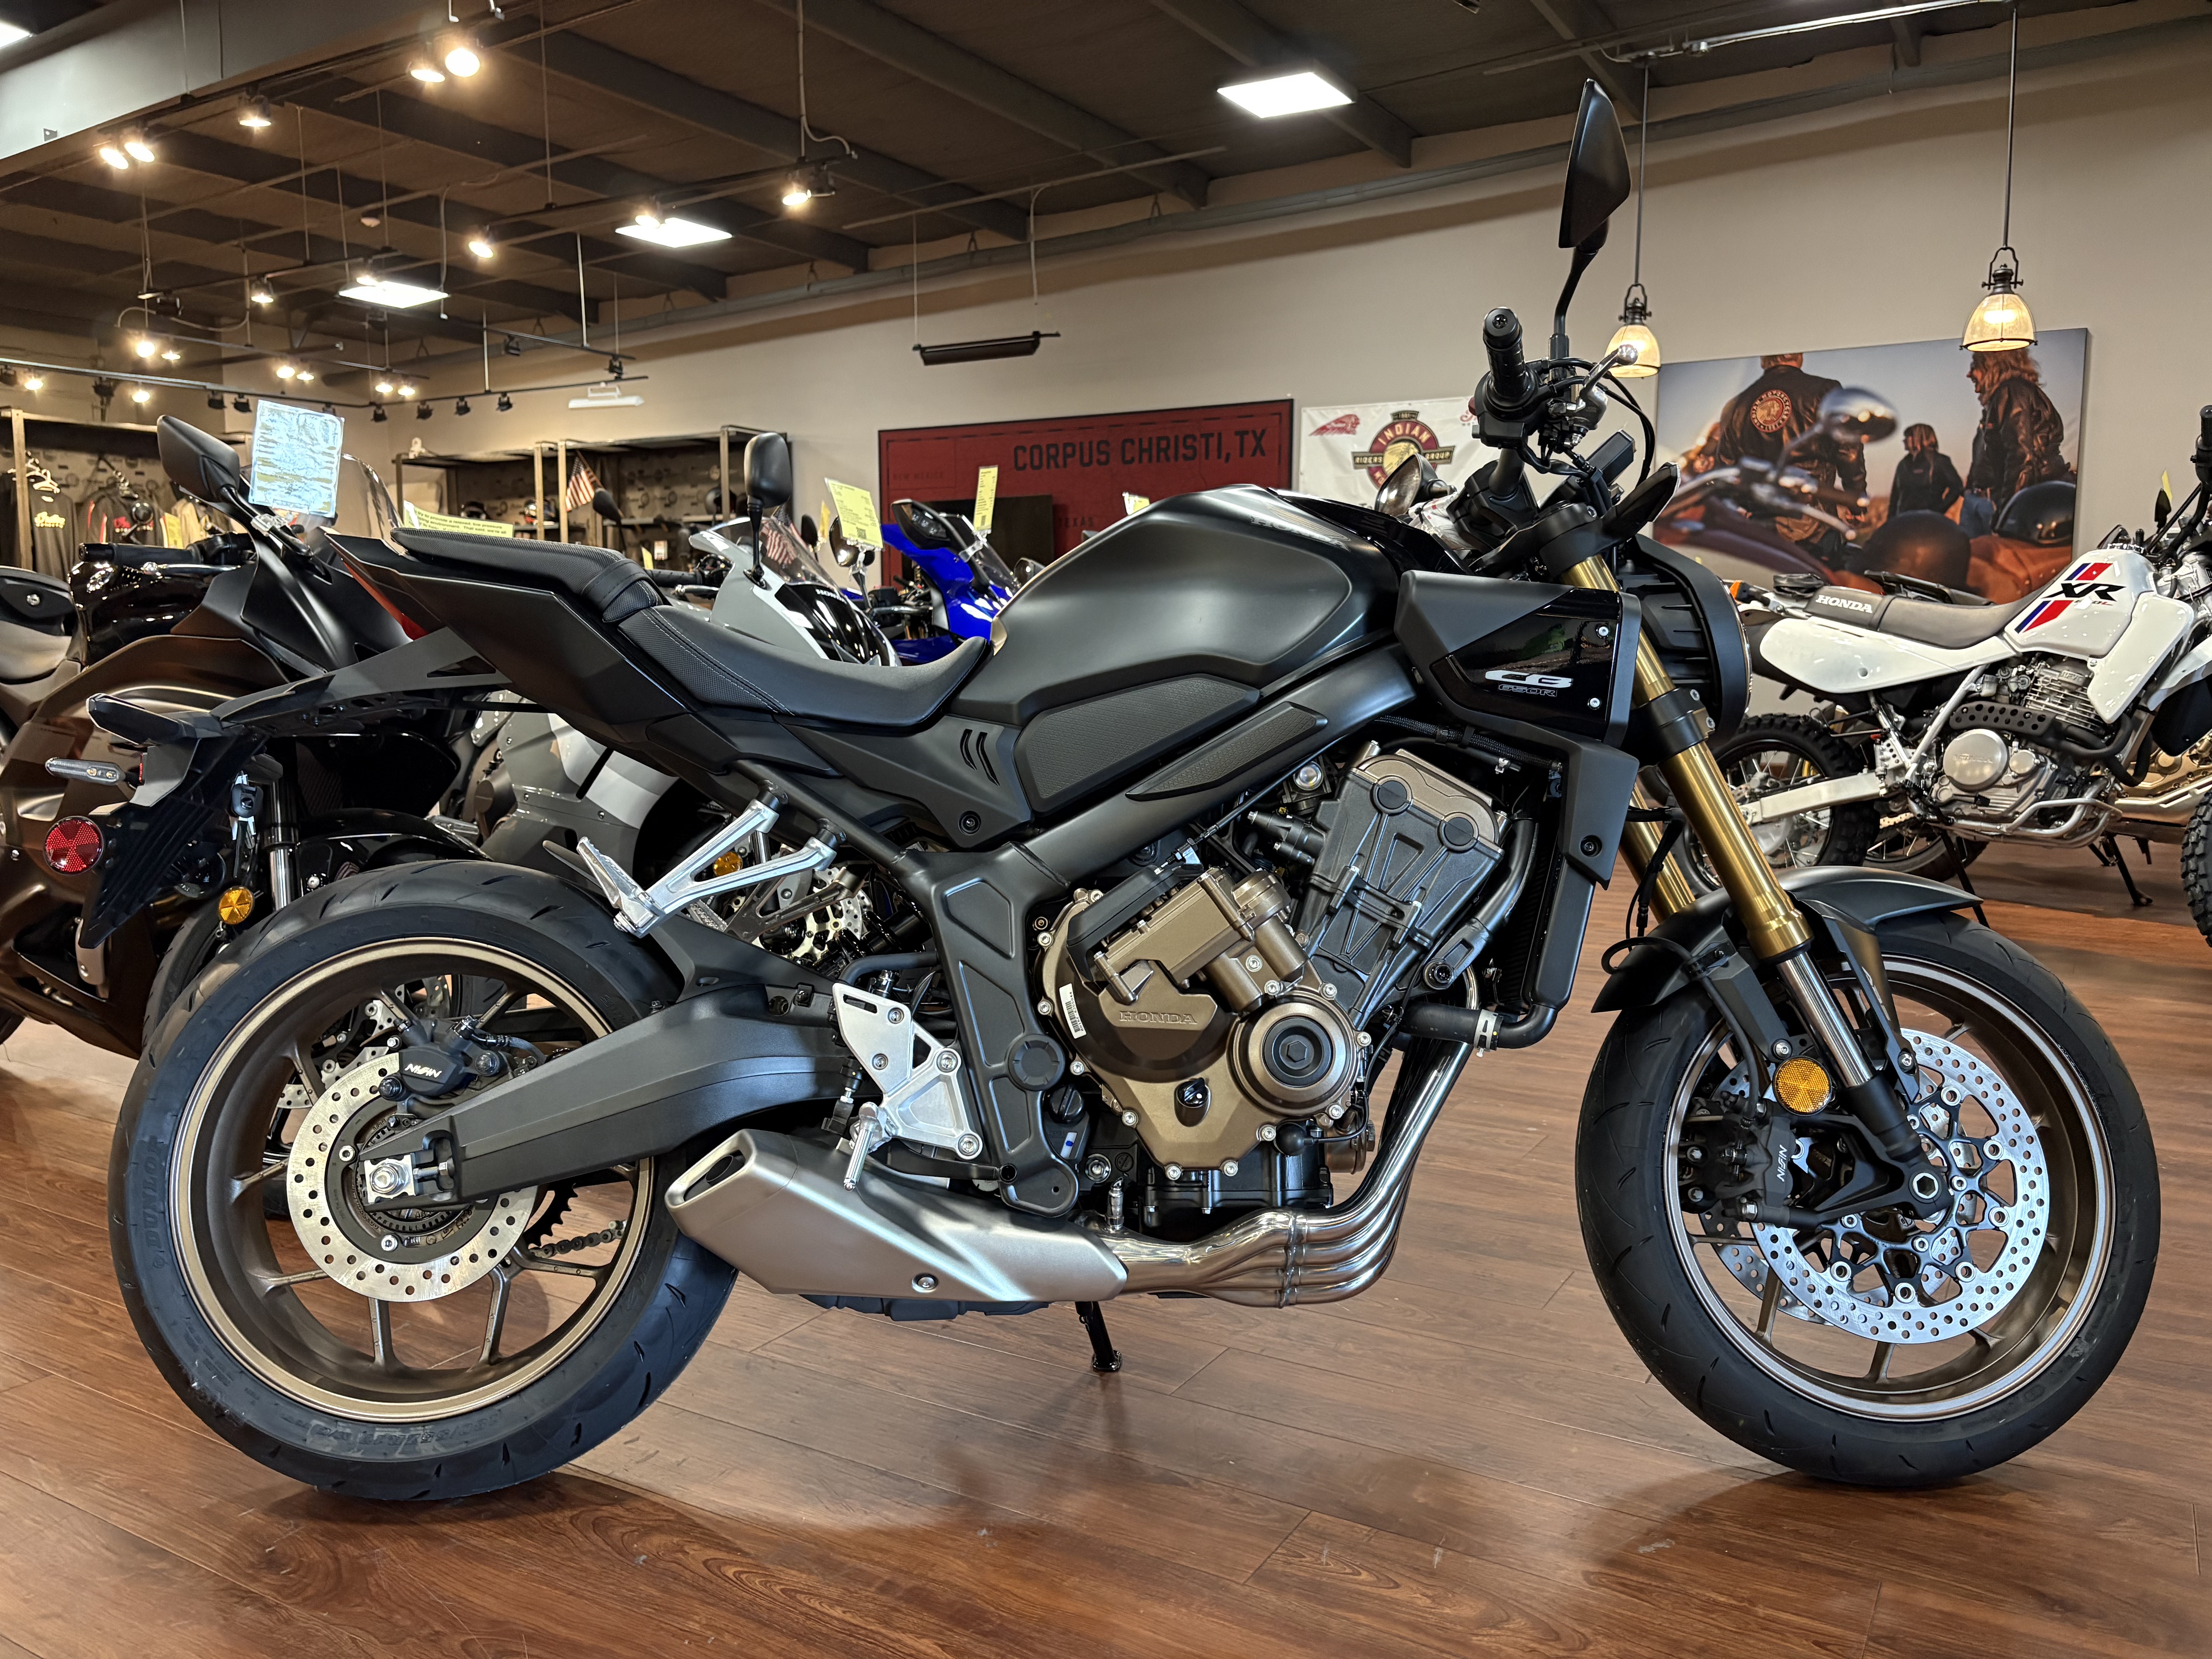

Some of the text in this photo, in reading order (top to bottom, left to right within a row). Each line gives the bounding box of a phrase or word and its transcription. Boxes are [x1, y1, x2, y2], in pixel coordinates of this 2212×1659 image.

[1378, 424, 1431, 445] INDIAN
[1013, 440, 1111, 471] CORPUS
[1425, 452, 1451, 460] GROUP
[815, 589, 847, 605] HONDA
[2040, 582, 2127, 602] XR
[1815, 594, 1873, 613] HONDA
[1485, 670, 1573, 688] CB
[1498, 684, 1556, 697] 650R
[1119, 1011, 1197, 1025] HONDA
[142, 1135, 162, 1249] DUNLOP
